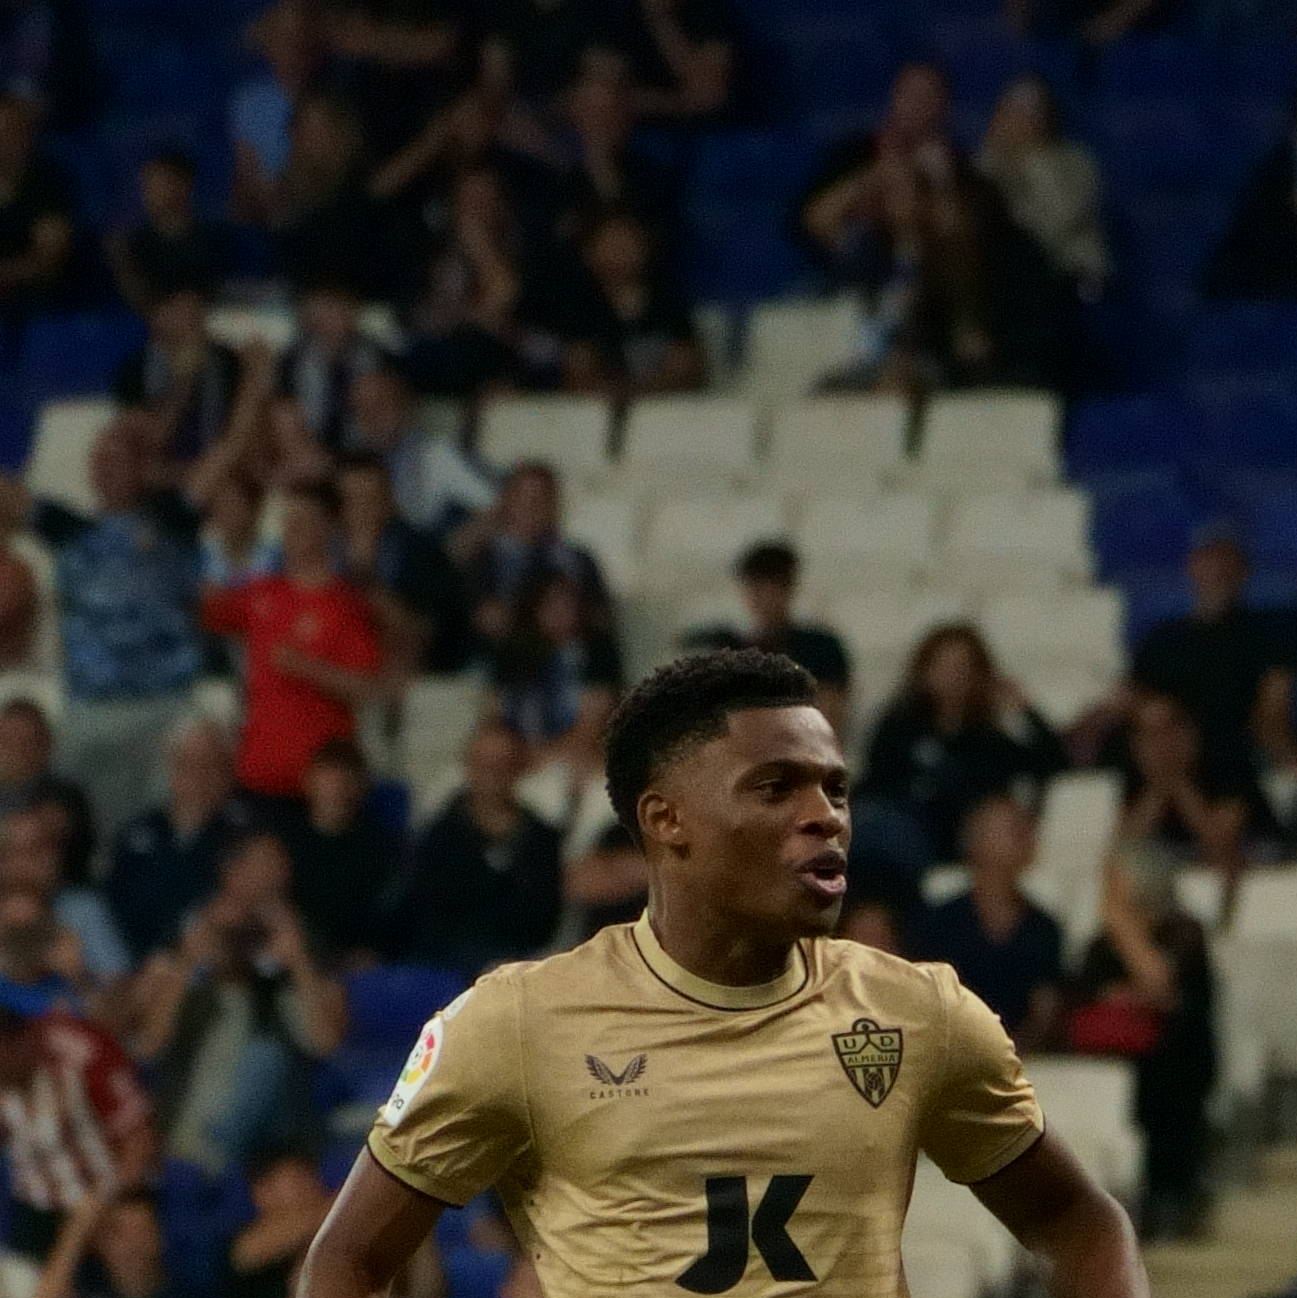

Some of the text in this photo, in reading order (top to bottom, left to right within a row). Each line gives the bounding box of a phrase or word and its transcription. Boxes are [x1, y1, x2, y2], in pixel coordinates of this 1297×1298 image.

[843, 1034, 894, 1051] U D
[847, 1053, 896, 1065] ALMERIA
[589, 1087, 650, 1100] CASTORE
[674, 1173, 819, 1295] JK
